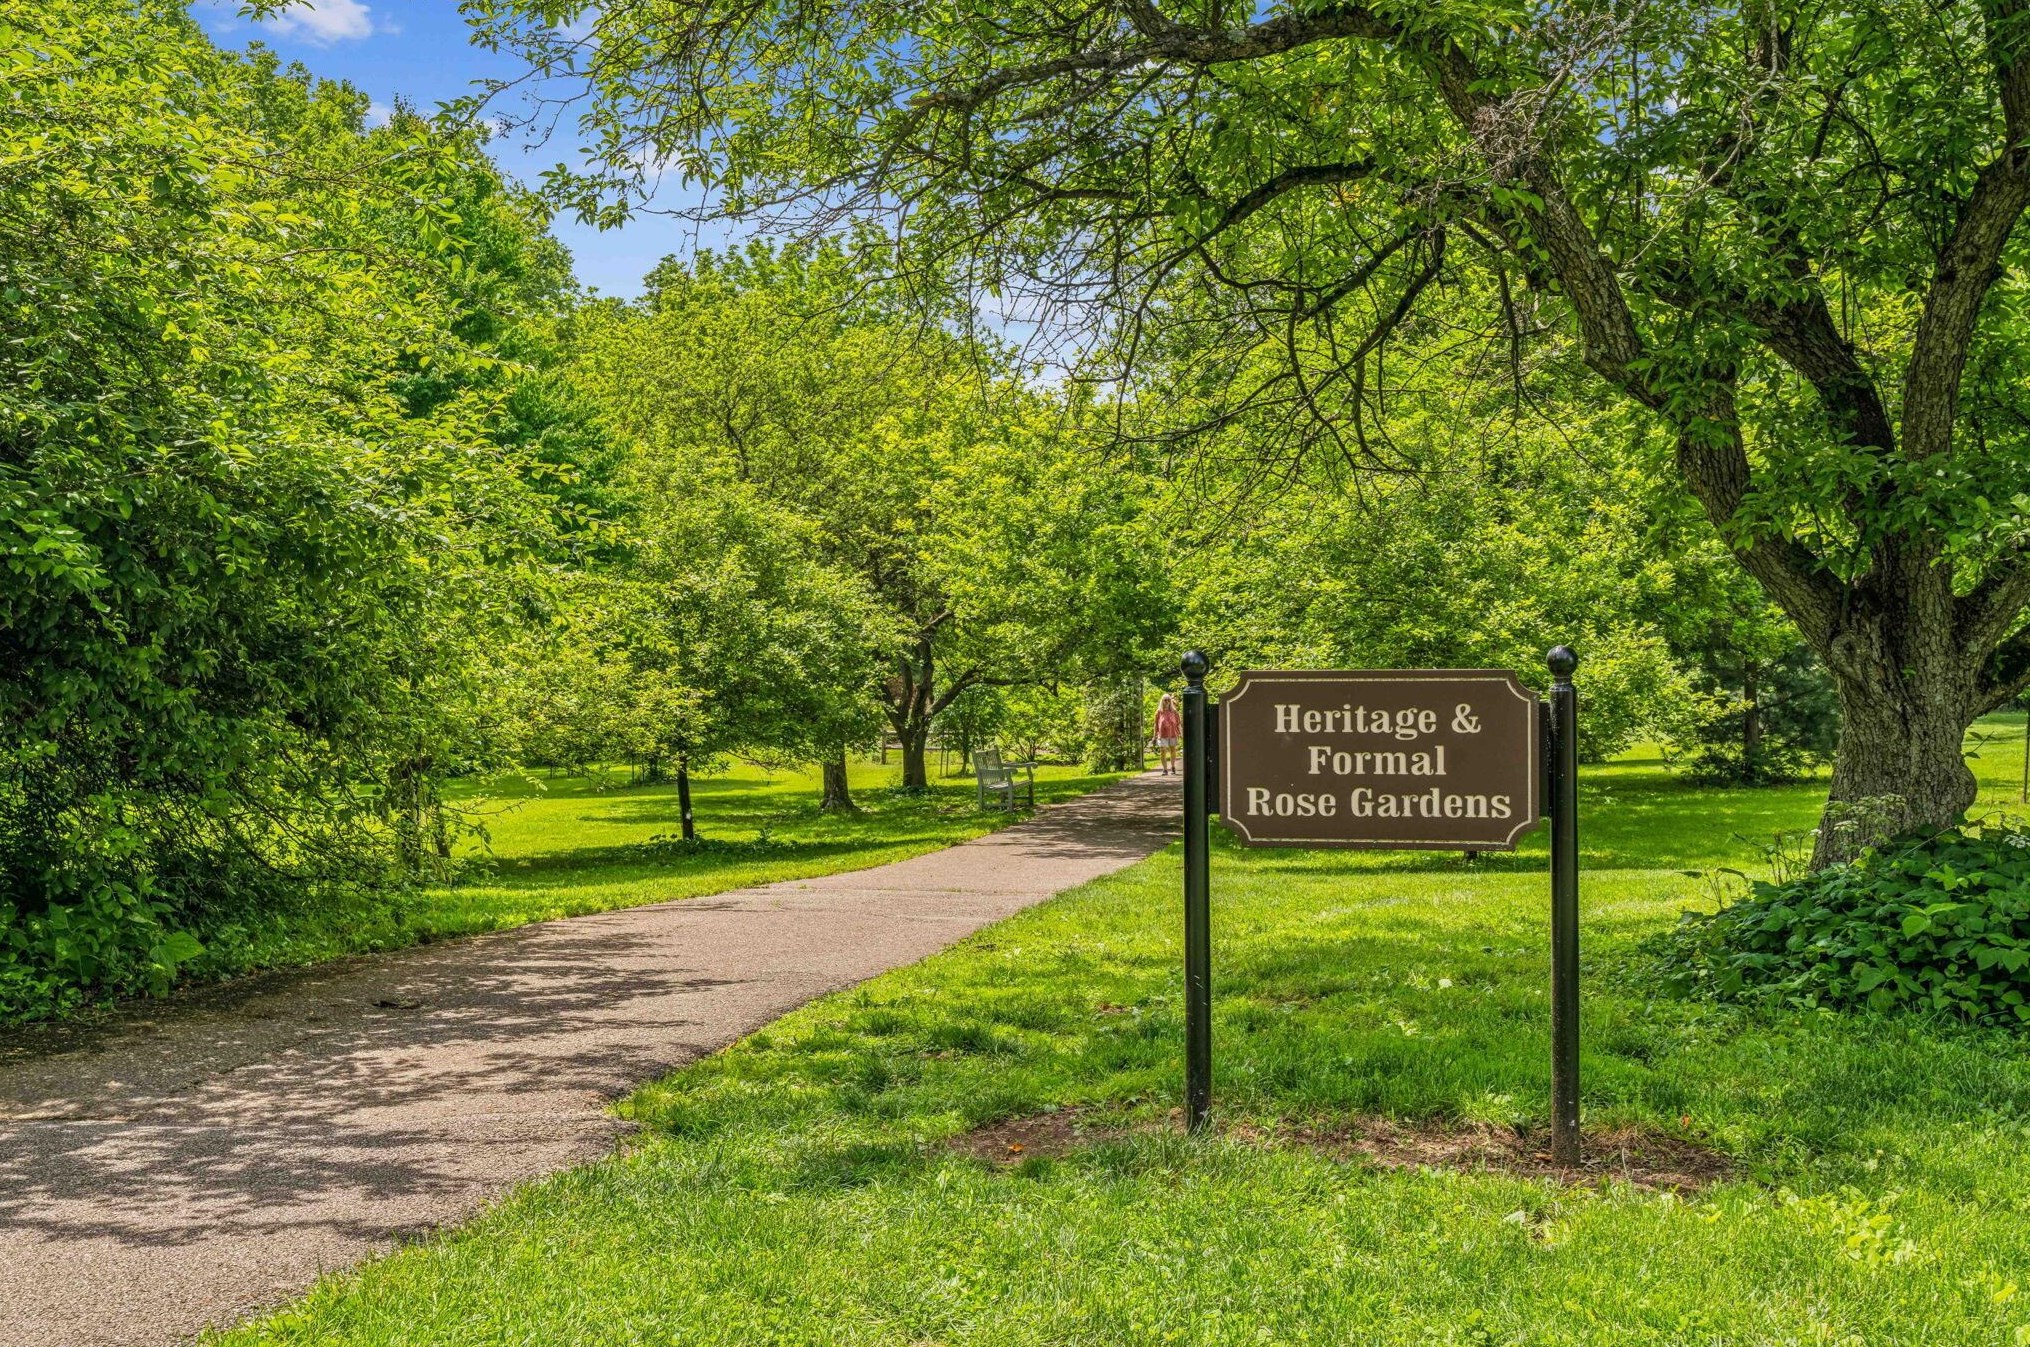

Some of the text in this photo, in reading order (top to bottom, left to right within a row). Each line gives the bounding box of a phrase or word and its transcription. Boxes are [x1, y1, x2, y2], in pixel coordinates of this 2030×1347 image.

[1274, 703, 1482, 741] Heritage &
[1307, 745, 1447, 776] Formal
[1246, 787, 1512, 819] Rose Gardens
